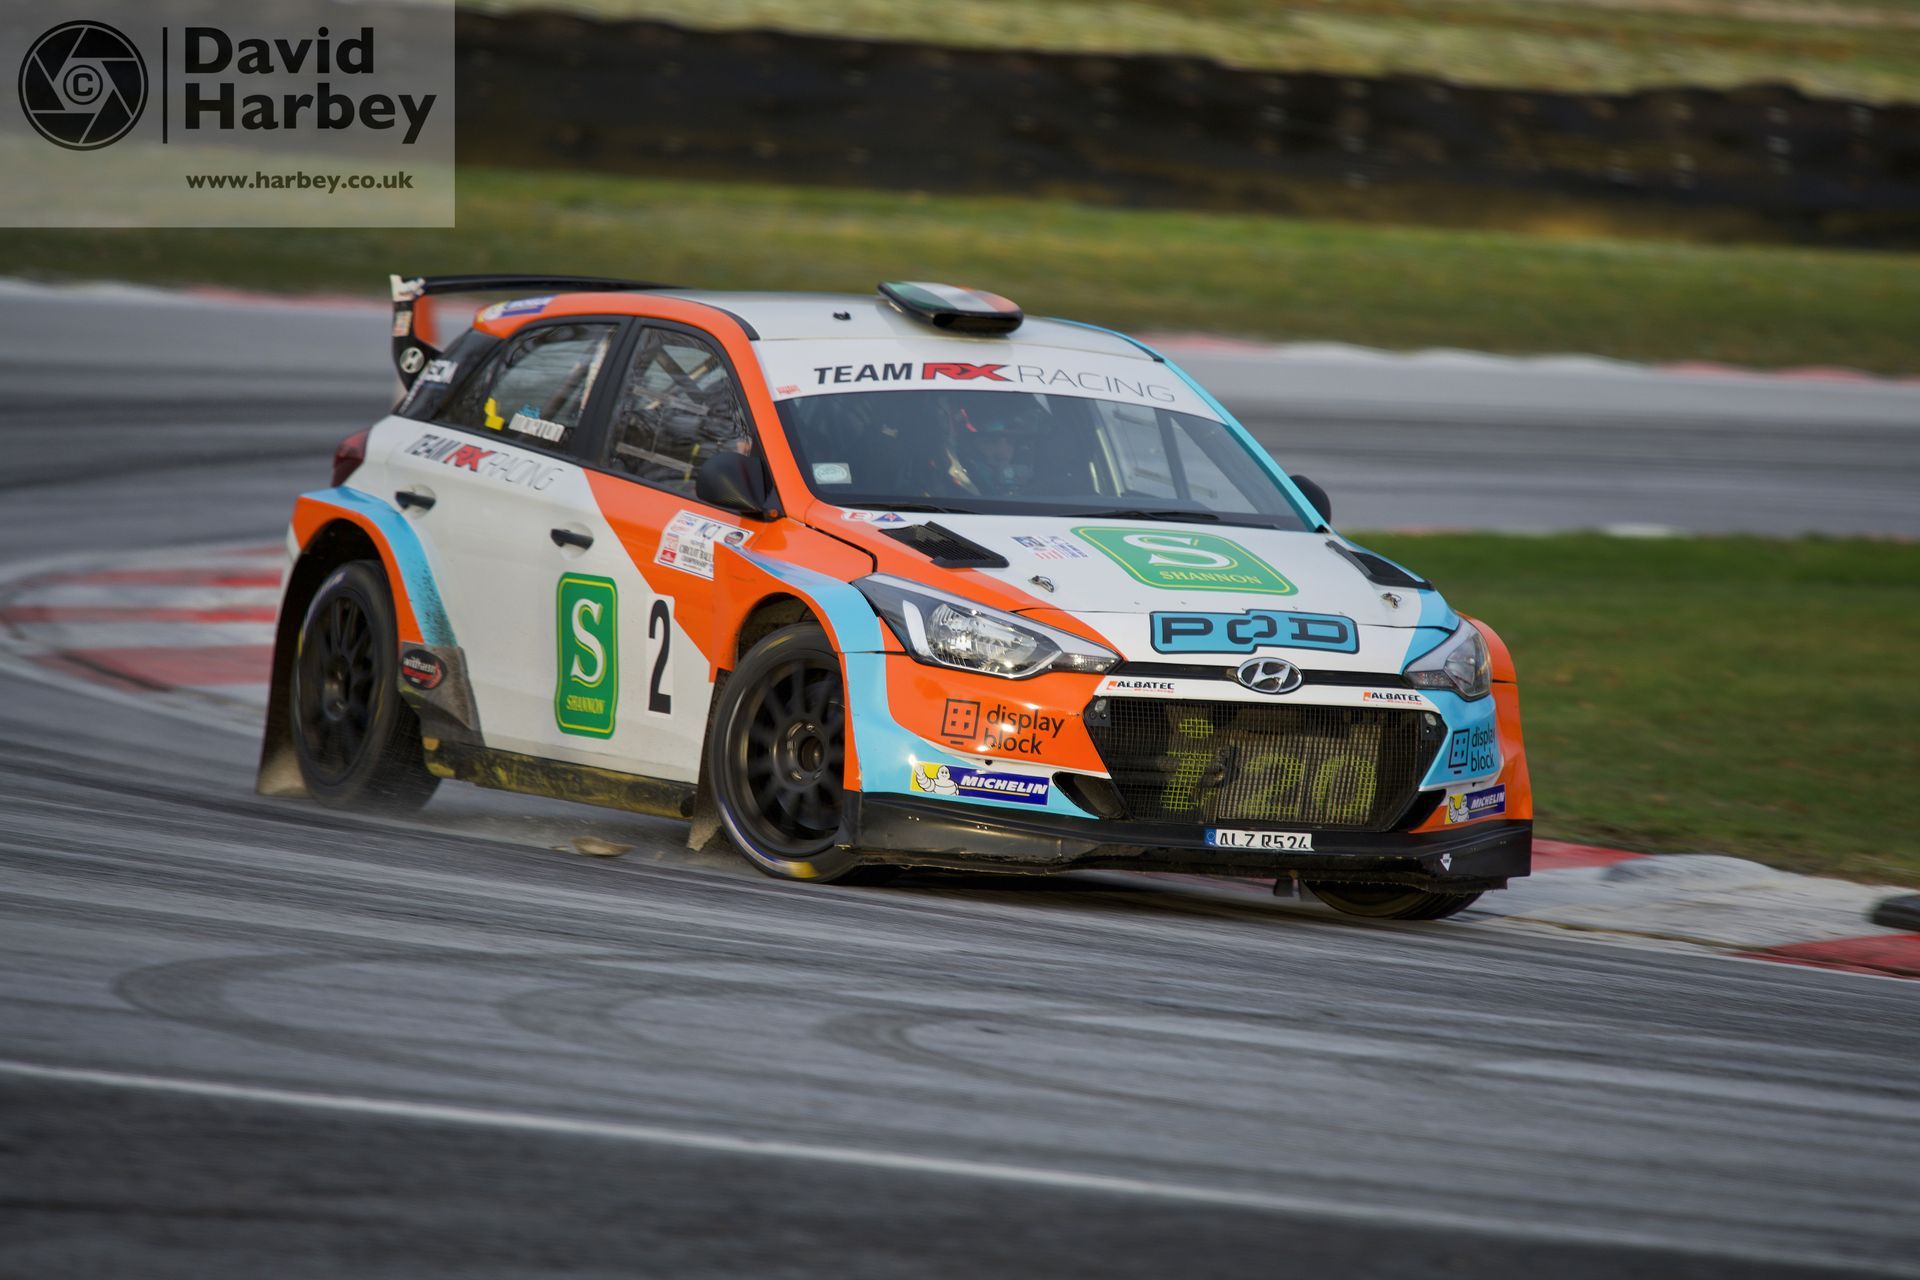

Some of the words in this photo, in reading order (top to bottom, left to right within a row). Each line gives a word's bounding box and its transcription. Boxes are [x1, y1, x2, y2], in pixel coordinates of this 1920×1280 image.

[814, 362, 913, 385] TEAM
[921, 362, 1013, 382] RX
[1018, 364, 1175, 402] RACING
[404, 433, 462, 463] TEAM
[443, 443, 496, 472] RX
[482, 451, 566, 491] RACING
[1123, 534, 1231, 569] S
[1158, 570, 1262, 585] SHANNON
[570, 598, 607, 688] S
[648, 599, 672, 715] 2
[1117, 680, 1175, 690] ALBATEC
[1371, 691, 1421, 702] ALBATEC
[566, 694, 605, 715] SHANNON
[986, 703, 1065, 738] display
[983, 727, 1043, 755] block
[1470, 751, 1495, 772] block
[960, 775, 1048, 795] MICHELIN
[1470, 791, 1506, 810] MICHELIN
